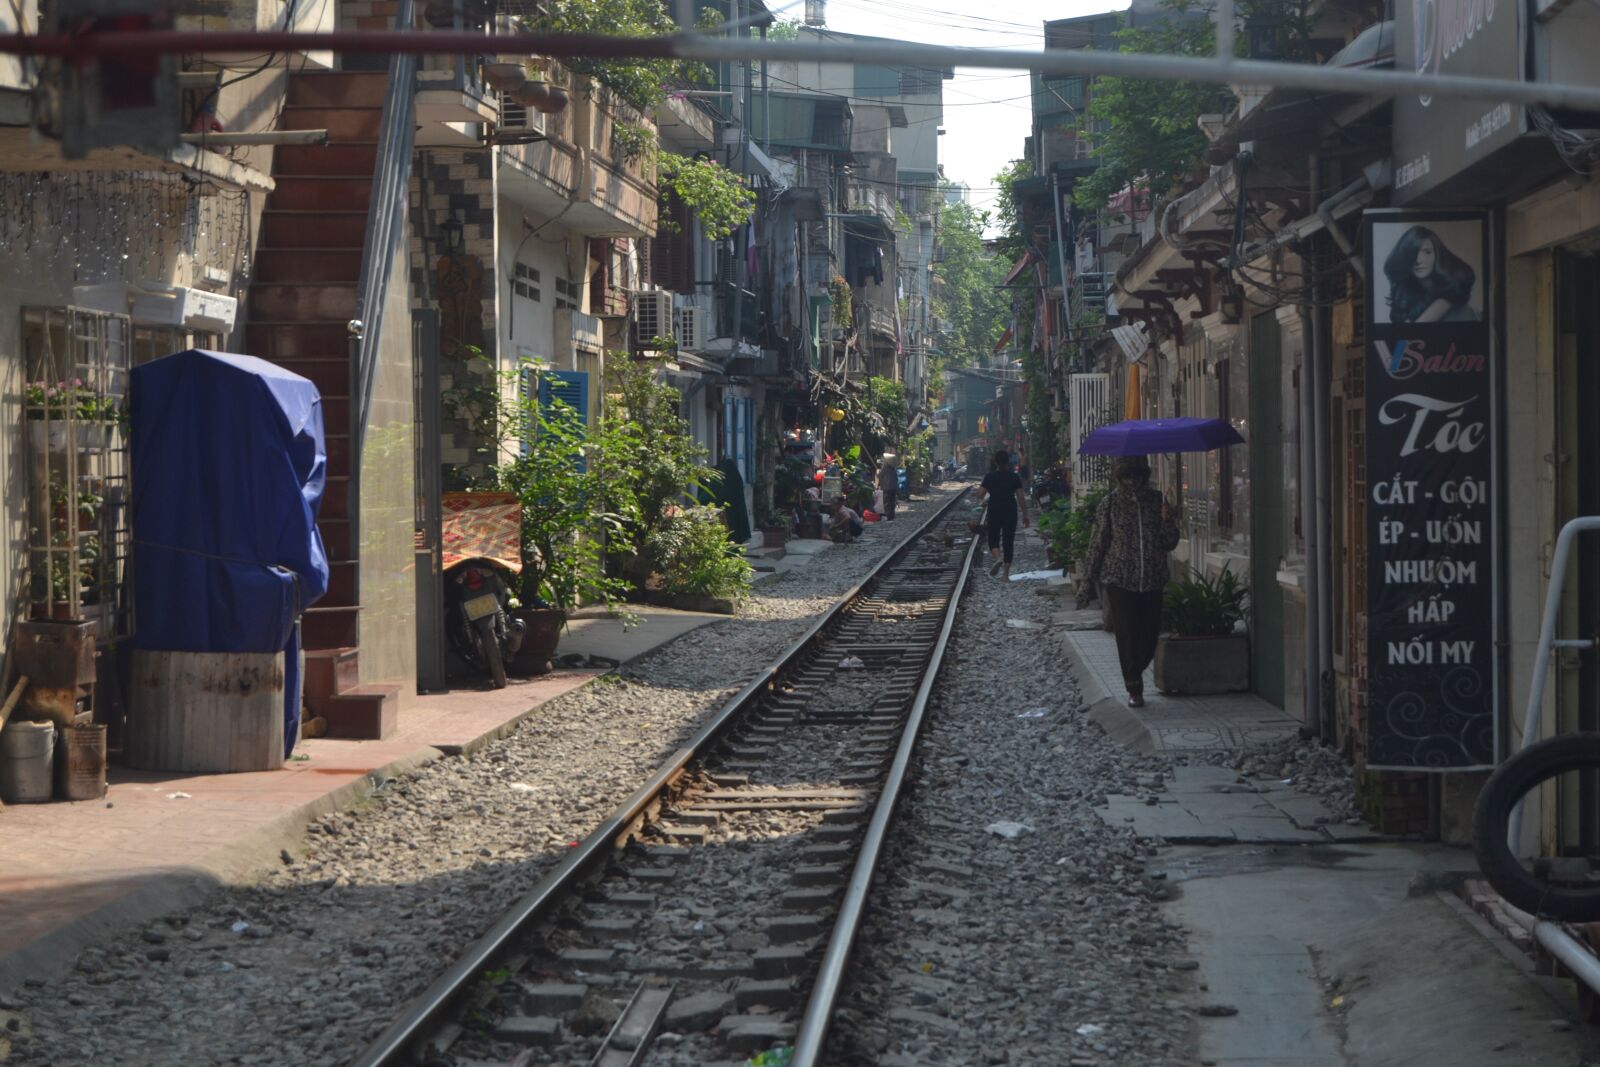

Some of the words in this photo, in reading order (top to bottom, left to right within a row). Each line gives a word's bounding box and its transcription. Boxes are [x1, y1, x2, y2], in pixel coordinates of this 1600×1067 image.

[1378, 393, 1486, 457] Tóc
[1373, 472, 1418, 504] CẮT
[1440, 475, 1486, 509] GỘI
[1379, 515, 1404, 544] ÉP
[1426, 513, 1481, 544] UỐN
[1384, 555, 1477, 589] NHUỘM
[1408, 593, 1455, 624] HẤP
[1387, 634, 1433, 665] NỐI
[1440, 641, 1475, 665] MY
